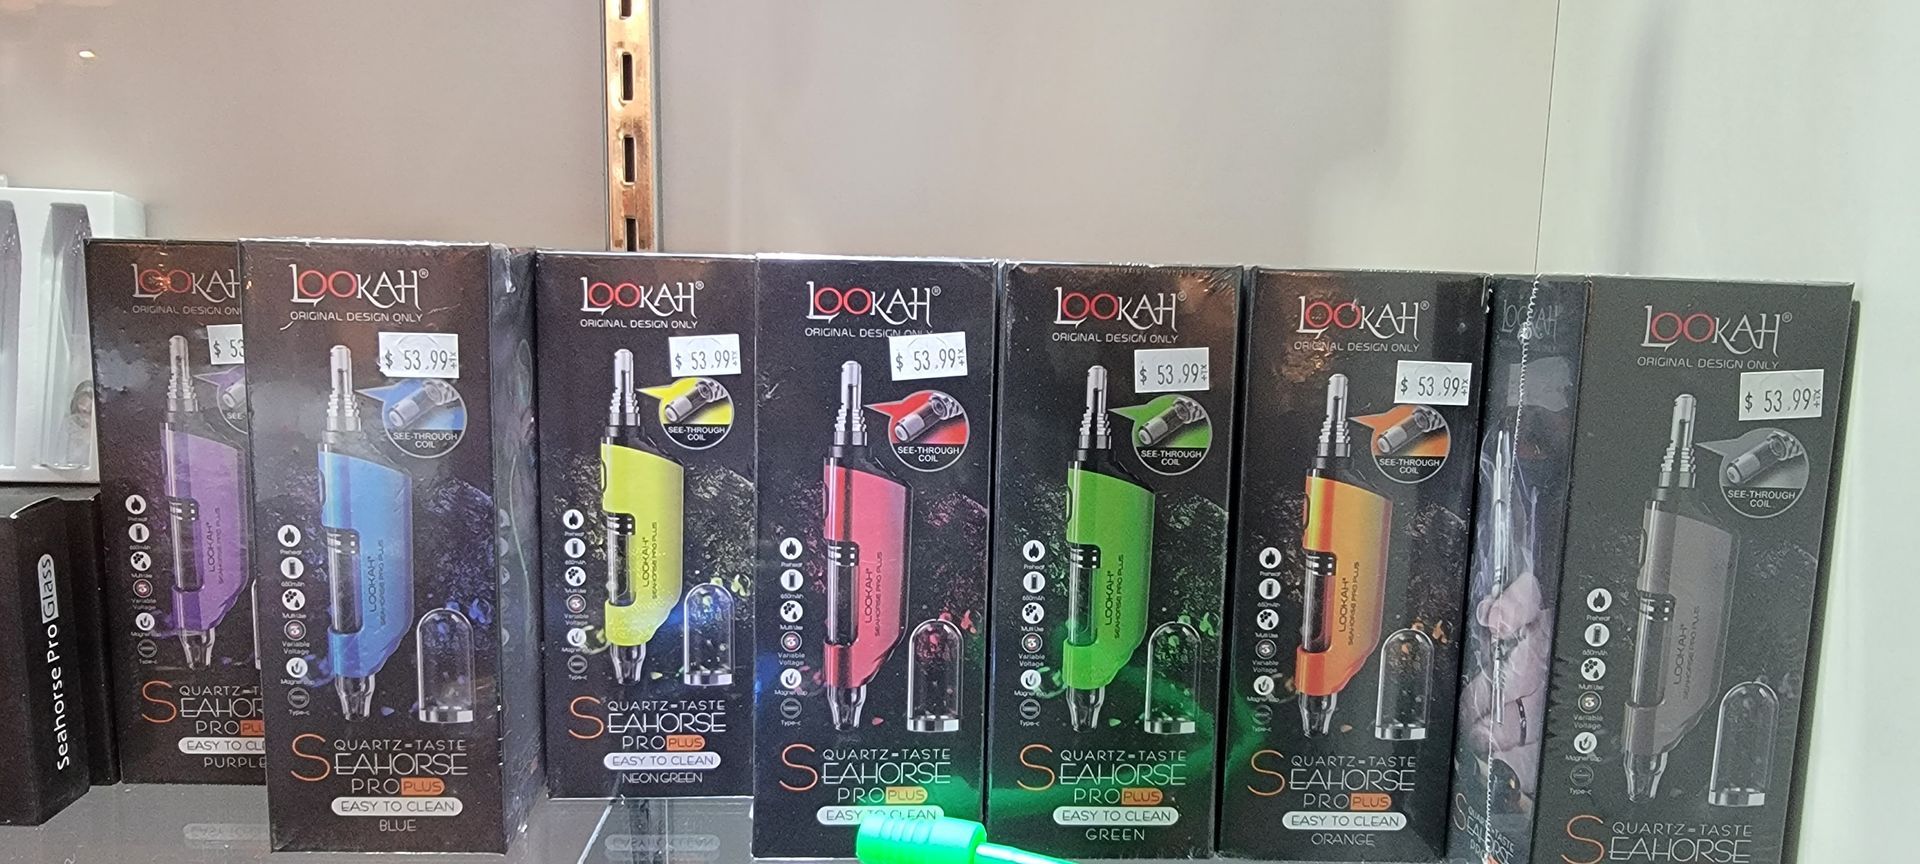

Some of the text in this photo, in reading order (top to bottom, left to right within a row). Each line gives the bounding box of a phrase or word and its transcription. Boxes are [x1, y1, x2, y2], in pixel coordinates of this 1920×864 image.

[132, 305, 240, 316] ORIGINAL DESIGN ON
[290, 311, 423, 323] ORIGINAL DESIGN ONLY
[580, 319, 698, 329] ORIGINAL DESIGN ONLY
[804, 328, 855, 337] ORIGINAL
[860, 328, 900, 338] DESIGN
[1052, 332, 1179, 344] ORIGINAL DESIGN ONLY
[1293, 341, 1420, 353] ORIGINAL DESIGN ONLY
[404, 349, 448, 371] 53.99
[691, 350, 731, 370] 53.99
[914, 348, 956, 371] 53.99
[1637, 356, 1780, 370] ORIGINAL DESIGN ONLY
[1157, 363, 1199, 385] 53.99
[1417, 376, 1460, 397] 53.99
[1763, 388, 1812, 413] 53.99
[393, 432, 457, 441] SEE-THROUGH
[415, 440, 436, 449] COIL
[898, 446, 960, 454] SEE-THROUGH
[918, 454, 939, 462] COIL
[1140, 450, 1202, 458] SEE-THROUGH
[1160, 458, 1181, 466] COIL
[1379, 458, 1440, 466] SEE-THROUGH
[1399, 466, 1419, 474] COIL
[1727, 490, 1796, 499] SEE-THROUGH
[1749, 499, 1772, 508] COIL
[41, 558, 70, 770] Seahorse Pro Glass
[568, 695, 726, 739] SEAHORSE
[196, 720, 240, 735] PRO
[187, 740, 220, 751] EASY
[224, 740, 242, 751] TO
[623, 736, 703, 750] PRO PLUS
[203, 756, 266, 769] PURPLE
[291, 733, 468, 781] SEAHORSE
[612, 755, 714, 766] EASY TO CLEAN
[779, 743, 951, 791] SEAHORSE
[1016, 743, 1187, 791] SEAHORSE
[1247, 749, 1416, 796] SEAHORSE
[352, 778, 442, 794] PRO PLUS
[837, 787, 925, 803] PRO PLUS
[1073, 788, 1161, 804] PRO PLUS
[1303, 793, 1390, 809] PRO PLUS
[341, 800, 455, 811] EASY TO CLEAN
[826, 809, 862, 821] EASY
[1062, 810, 1171, 821] EASY TO CLEAN
[1291, 815, 1400, 827] EASY TO CLEAN
[379, 819, 416, 831] BLUE
[1085, 828, 1146, 841] GREEN
[1311, 833, 1376, 847] ORANGE
[1561, 814, 1752, 864] SEAHORSE
